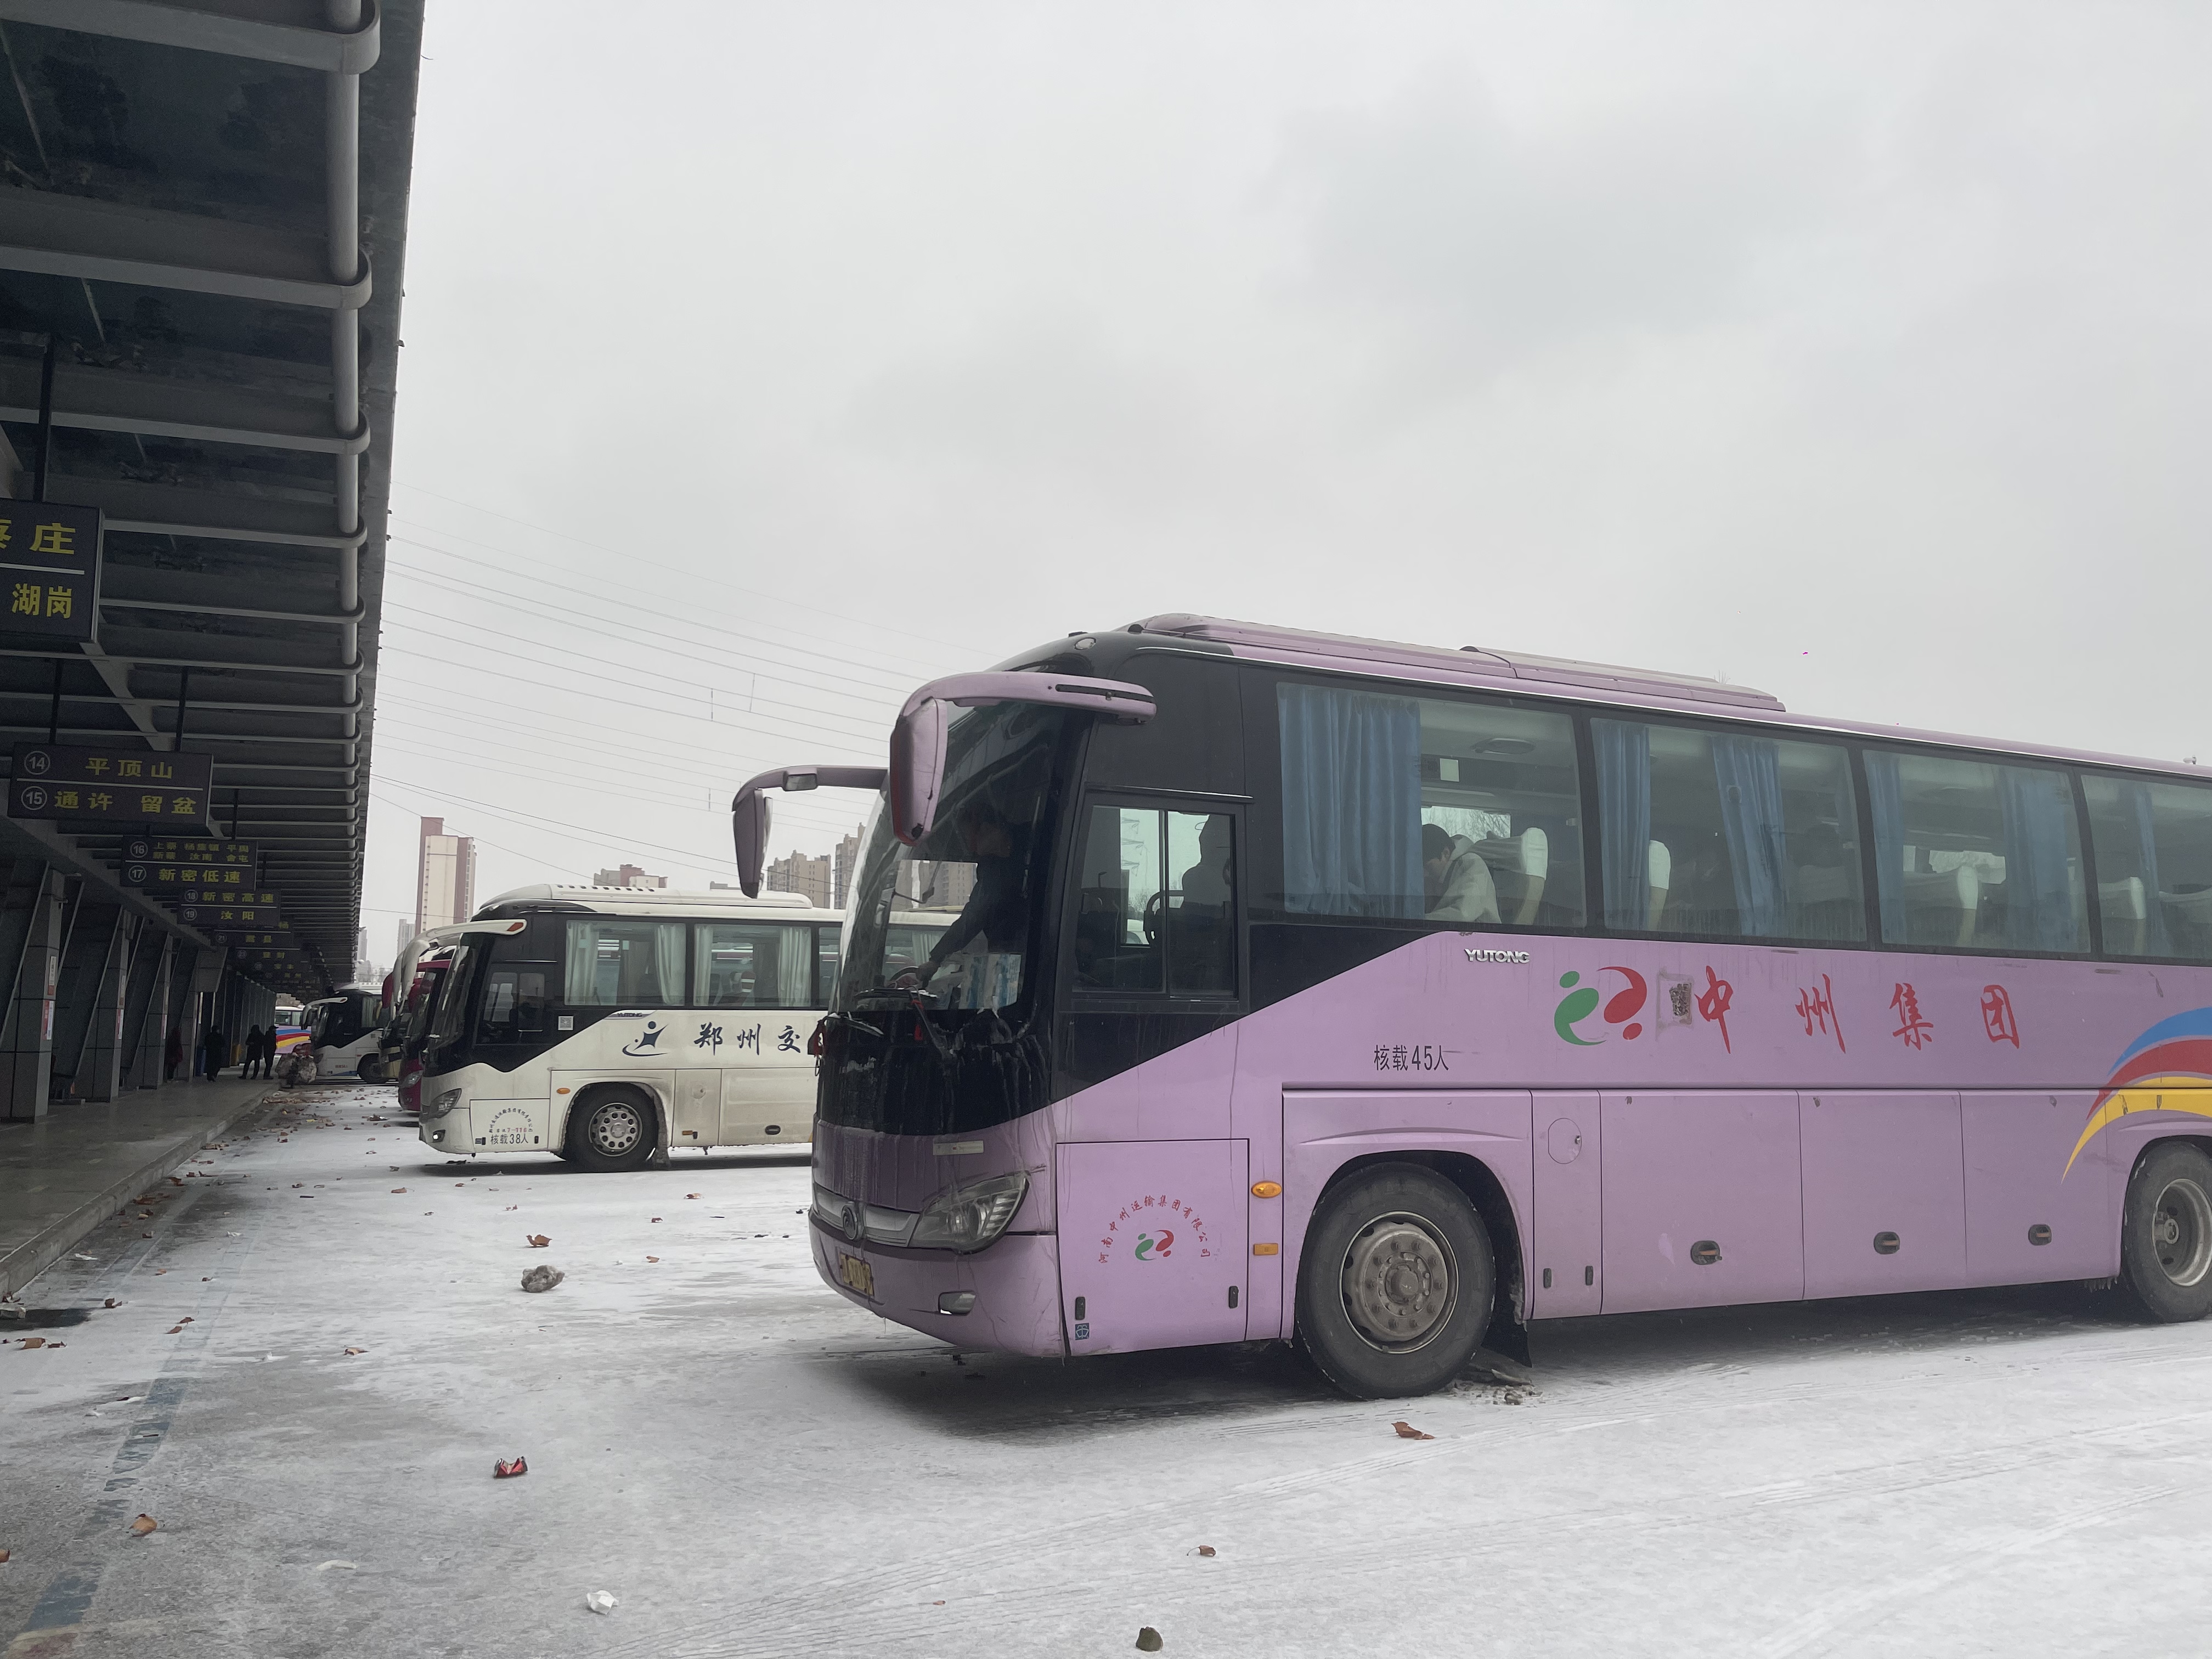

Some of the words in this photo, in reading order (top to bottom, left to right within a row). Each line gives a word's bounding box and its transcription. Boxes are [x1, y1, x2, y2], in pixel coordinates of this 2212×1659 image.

[0, 518, 76, 555] 庄
[12, 583, 72, 618] 湖岗
[85, 757, 173, 779] 平顶山
[54, 791, 113, 810] 通许
[140, 795, 197, 815] 留盆
[158, 868, 241, 883] 新密低速
[202, 891, 274, 903] 新密高速
[221, 911, 255, 921] 汝阳
[1464, 948, 1531, 964] YUTONG
[1694, 965, 2020, 1054] 中州集团
[1374, 1045, 1449, 1071] 核载45人
[490, 1133, 529, 1145] 核载38人
[1098, 1194, 1211, 1263] 河南中州运输集团有限公司
